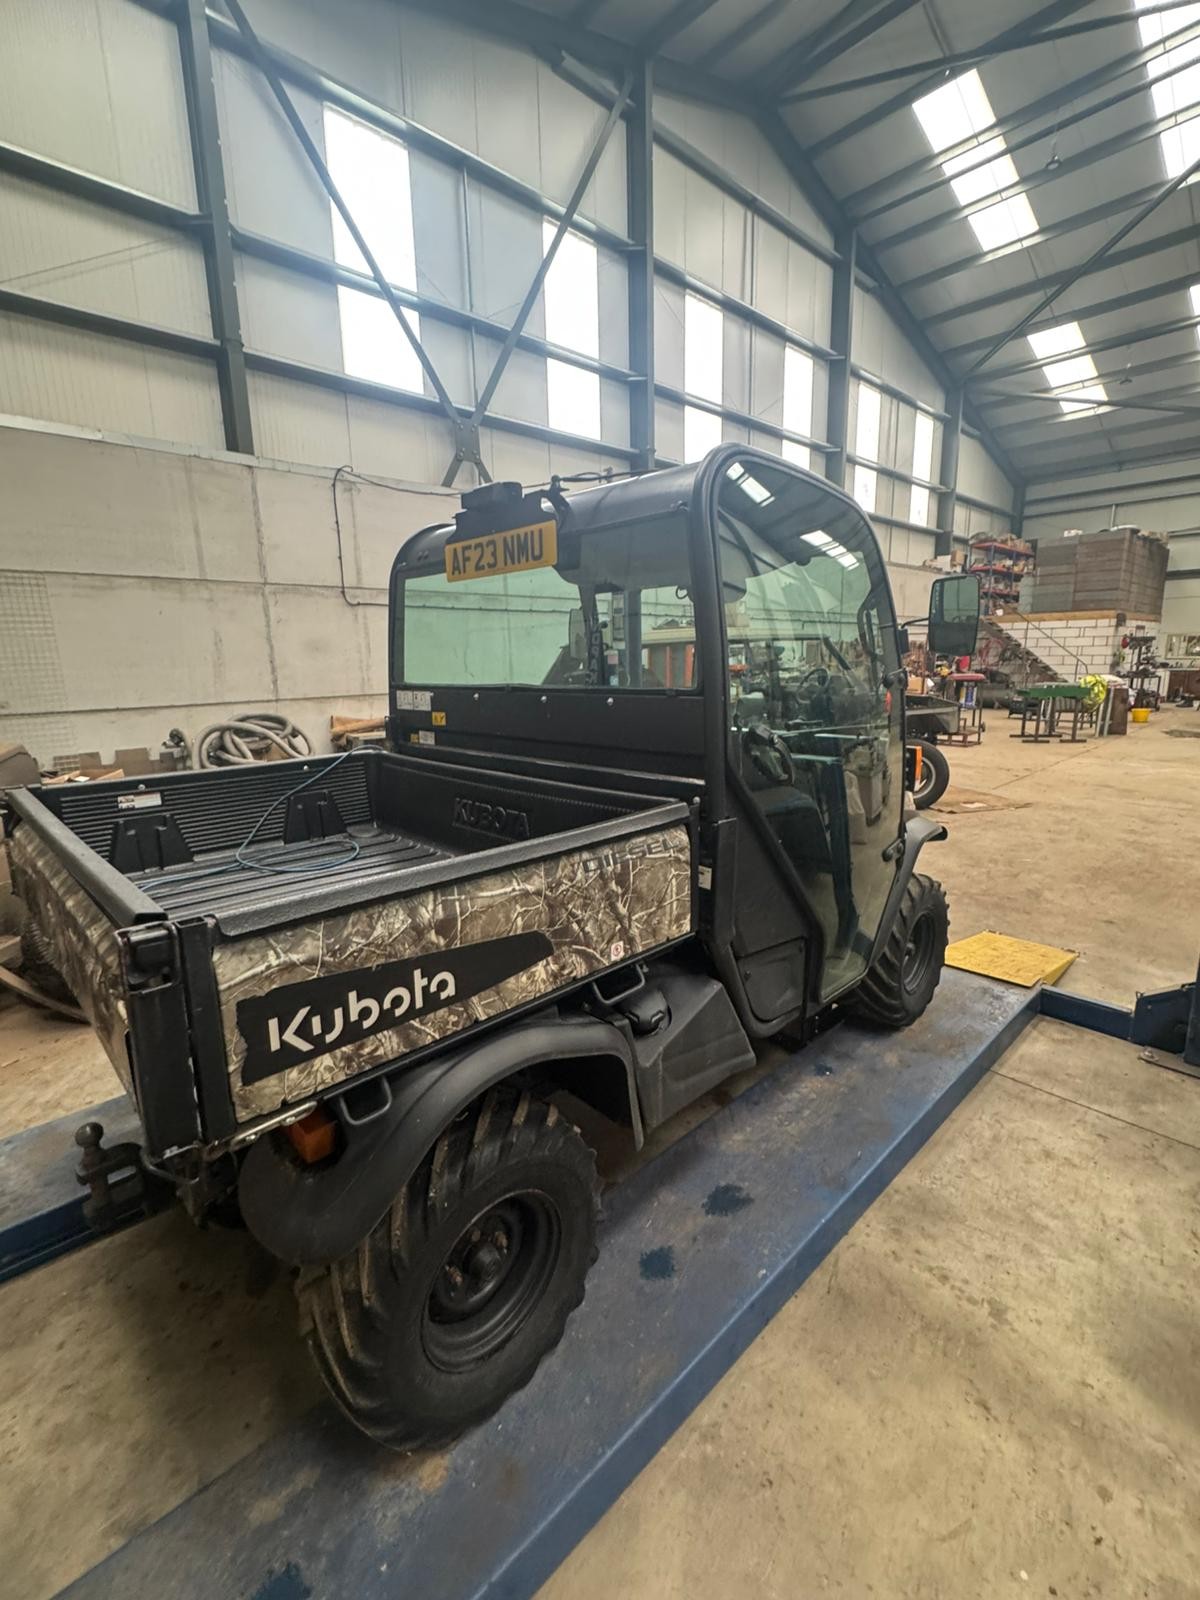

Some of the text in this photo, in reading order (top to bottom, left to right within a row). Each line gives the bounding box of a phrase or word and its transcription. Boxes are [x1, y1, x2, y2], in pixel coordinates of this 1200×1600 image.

[451, 528, 544, 576] AF23 NMU
[453, 797, 530, 839] KUBOTA
[582, 837, 679, 873] DIESEL
[268, 967, 456, 1053] Kubota
